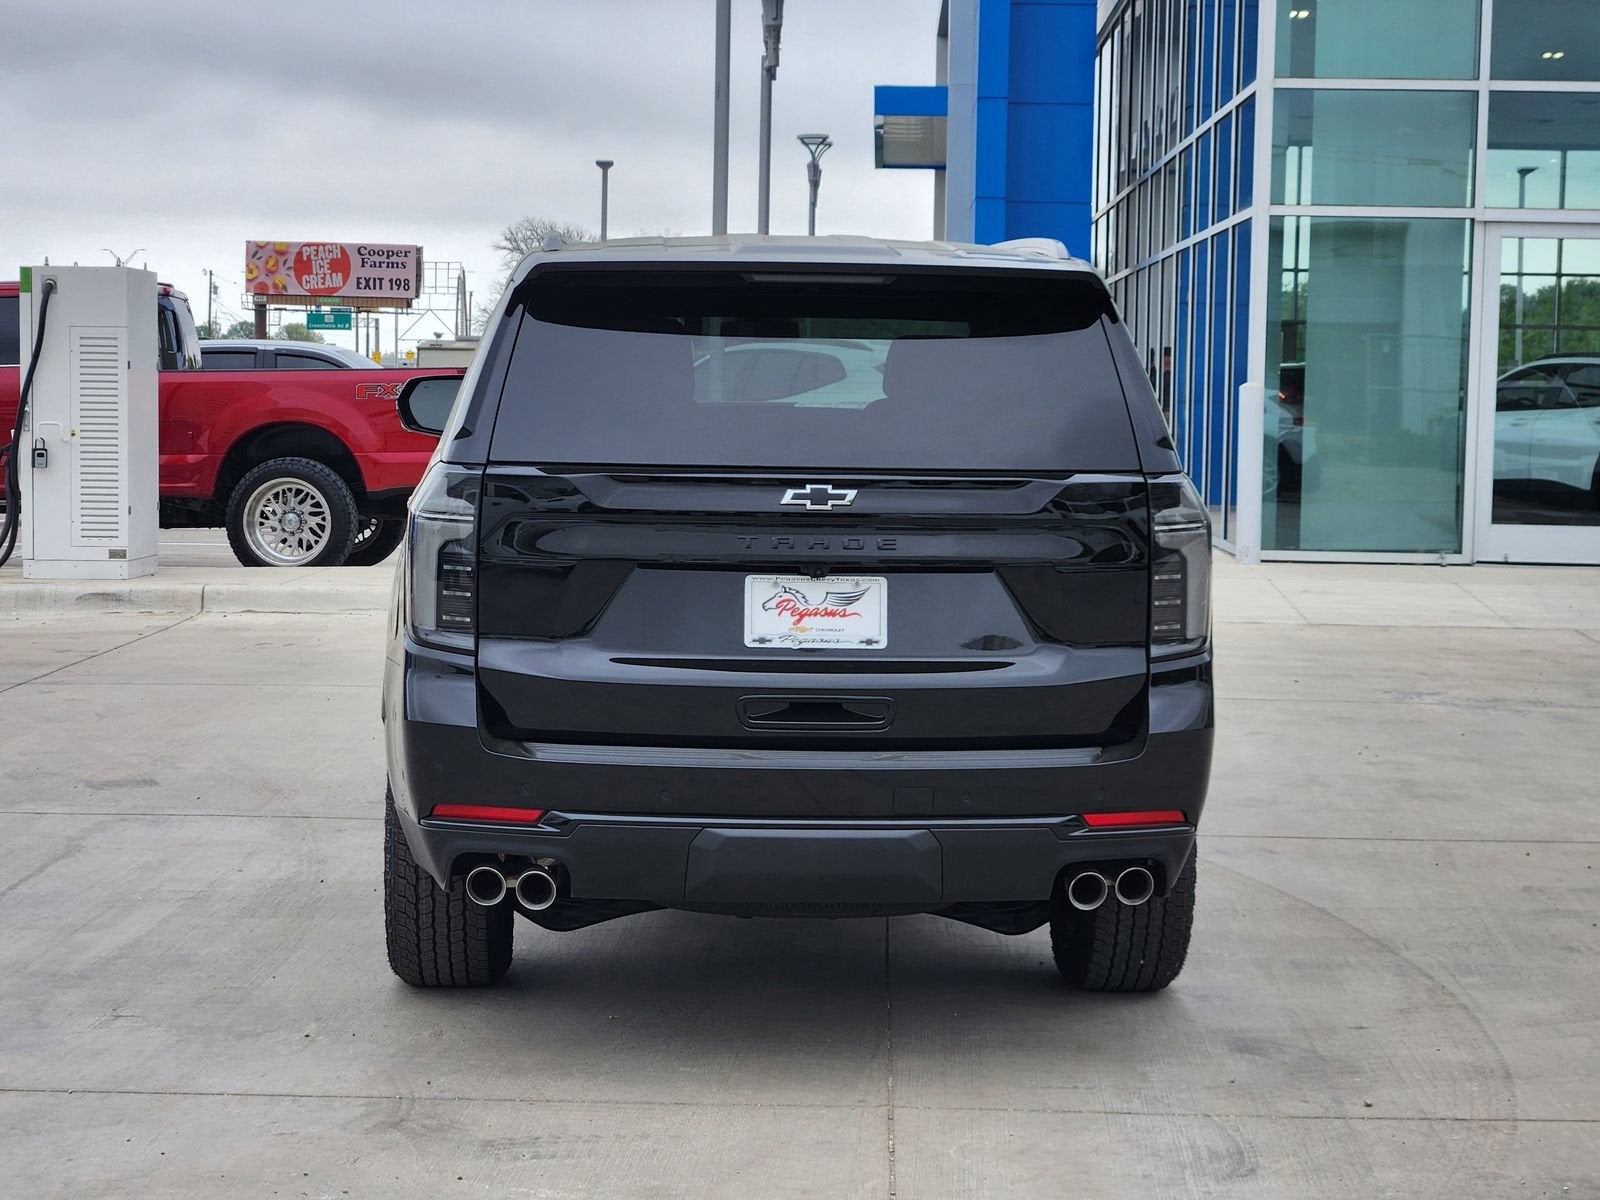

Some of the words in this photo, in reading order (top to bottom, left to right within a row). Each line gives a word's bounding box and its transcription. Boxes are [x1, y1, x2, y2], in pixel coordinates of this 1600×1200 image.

[302, 244, 342, 261] PEACH
[357, 246, 411, 259] Cooper
[312, 260, 331, 274] ICE
[360, 257, 407, 270] Farms
[302, 273, 344, 290] CREAM
[356, 276, 385, 291] EXIT
[388, 278, 411, 292] 198
[355, 383, 404, 400] FX
[737, 536, 897, 550] TAHOE
[775, 598, 863, 627] Pegasus
[778, 634, 847, 647] Pegasus
